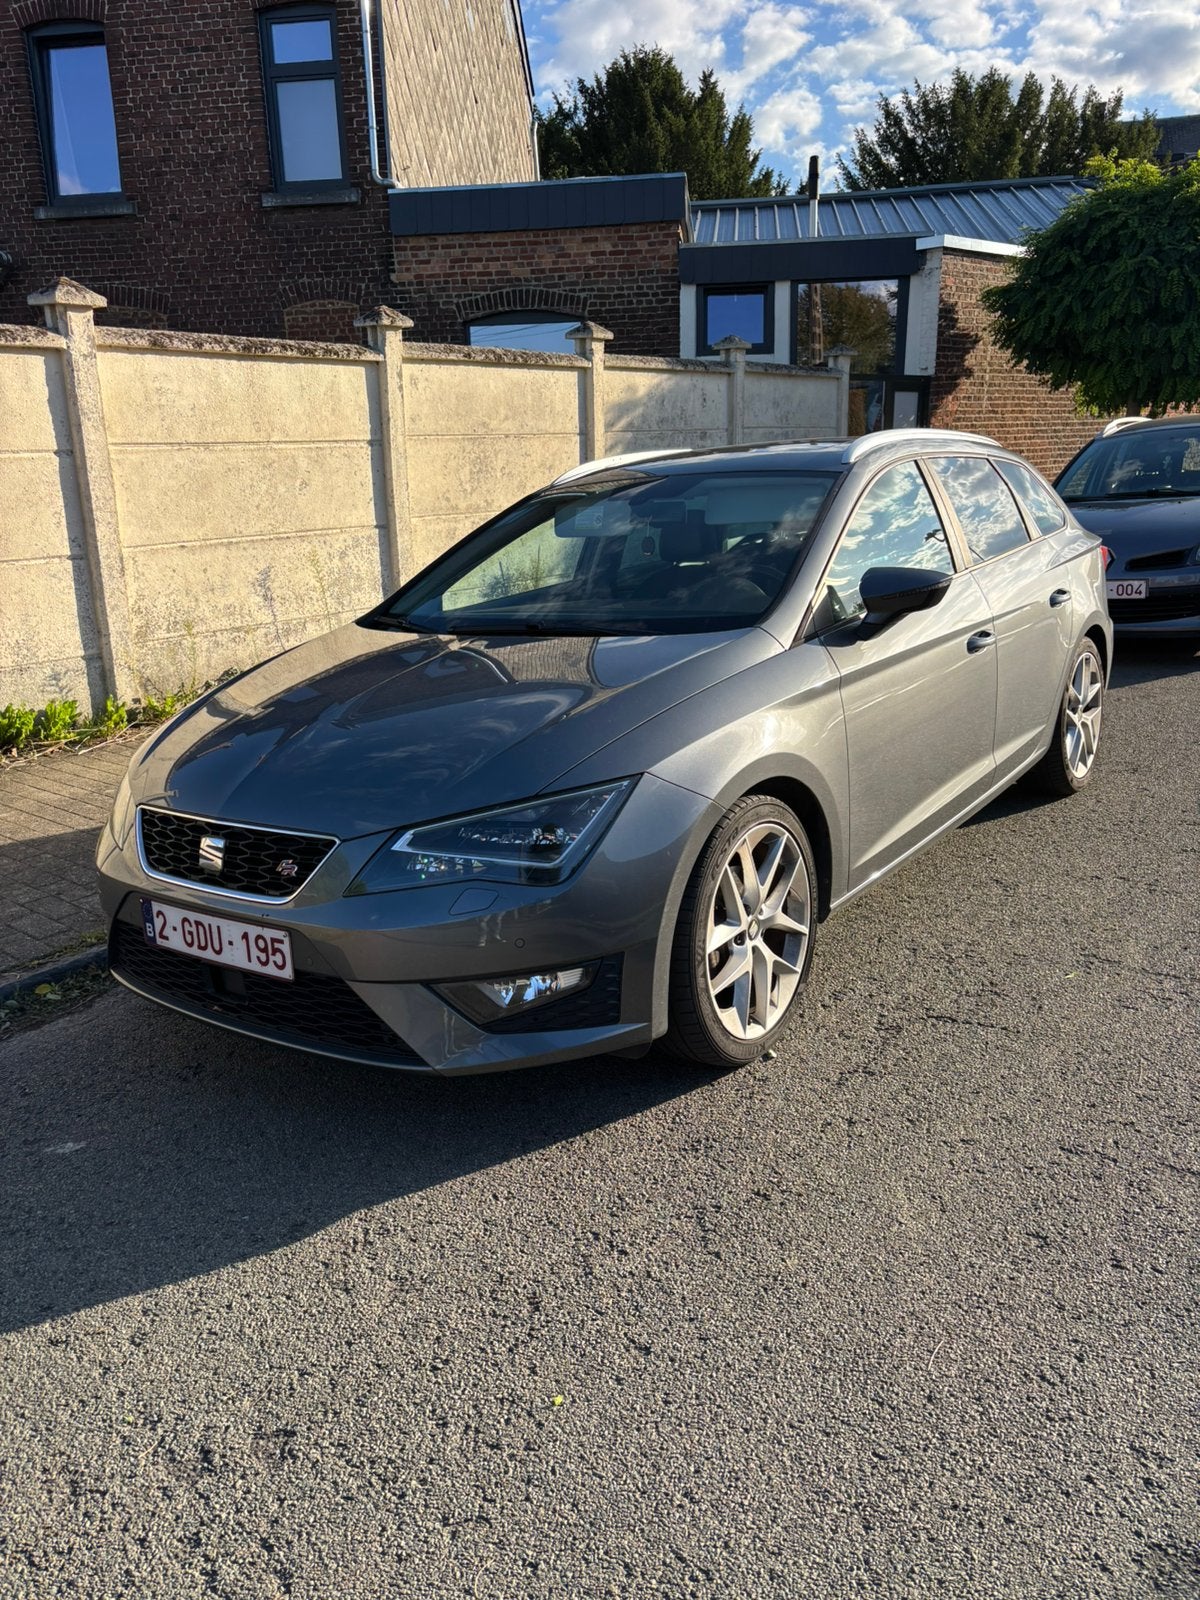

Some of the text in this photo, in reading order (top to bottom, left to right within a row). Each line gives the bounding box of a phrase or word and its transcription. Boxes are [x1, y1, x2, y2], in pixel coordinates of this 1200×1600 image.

[276, 859, 298, 878] FR
[145, 923, 155, 937] B
[155, 910, 287, 971] 2-GDU-195
